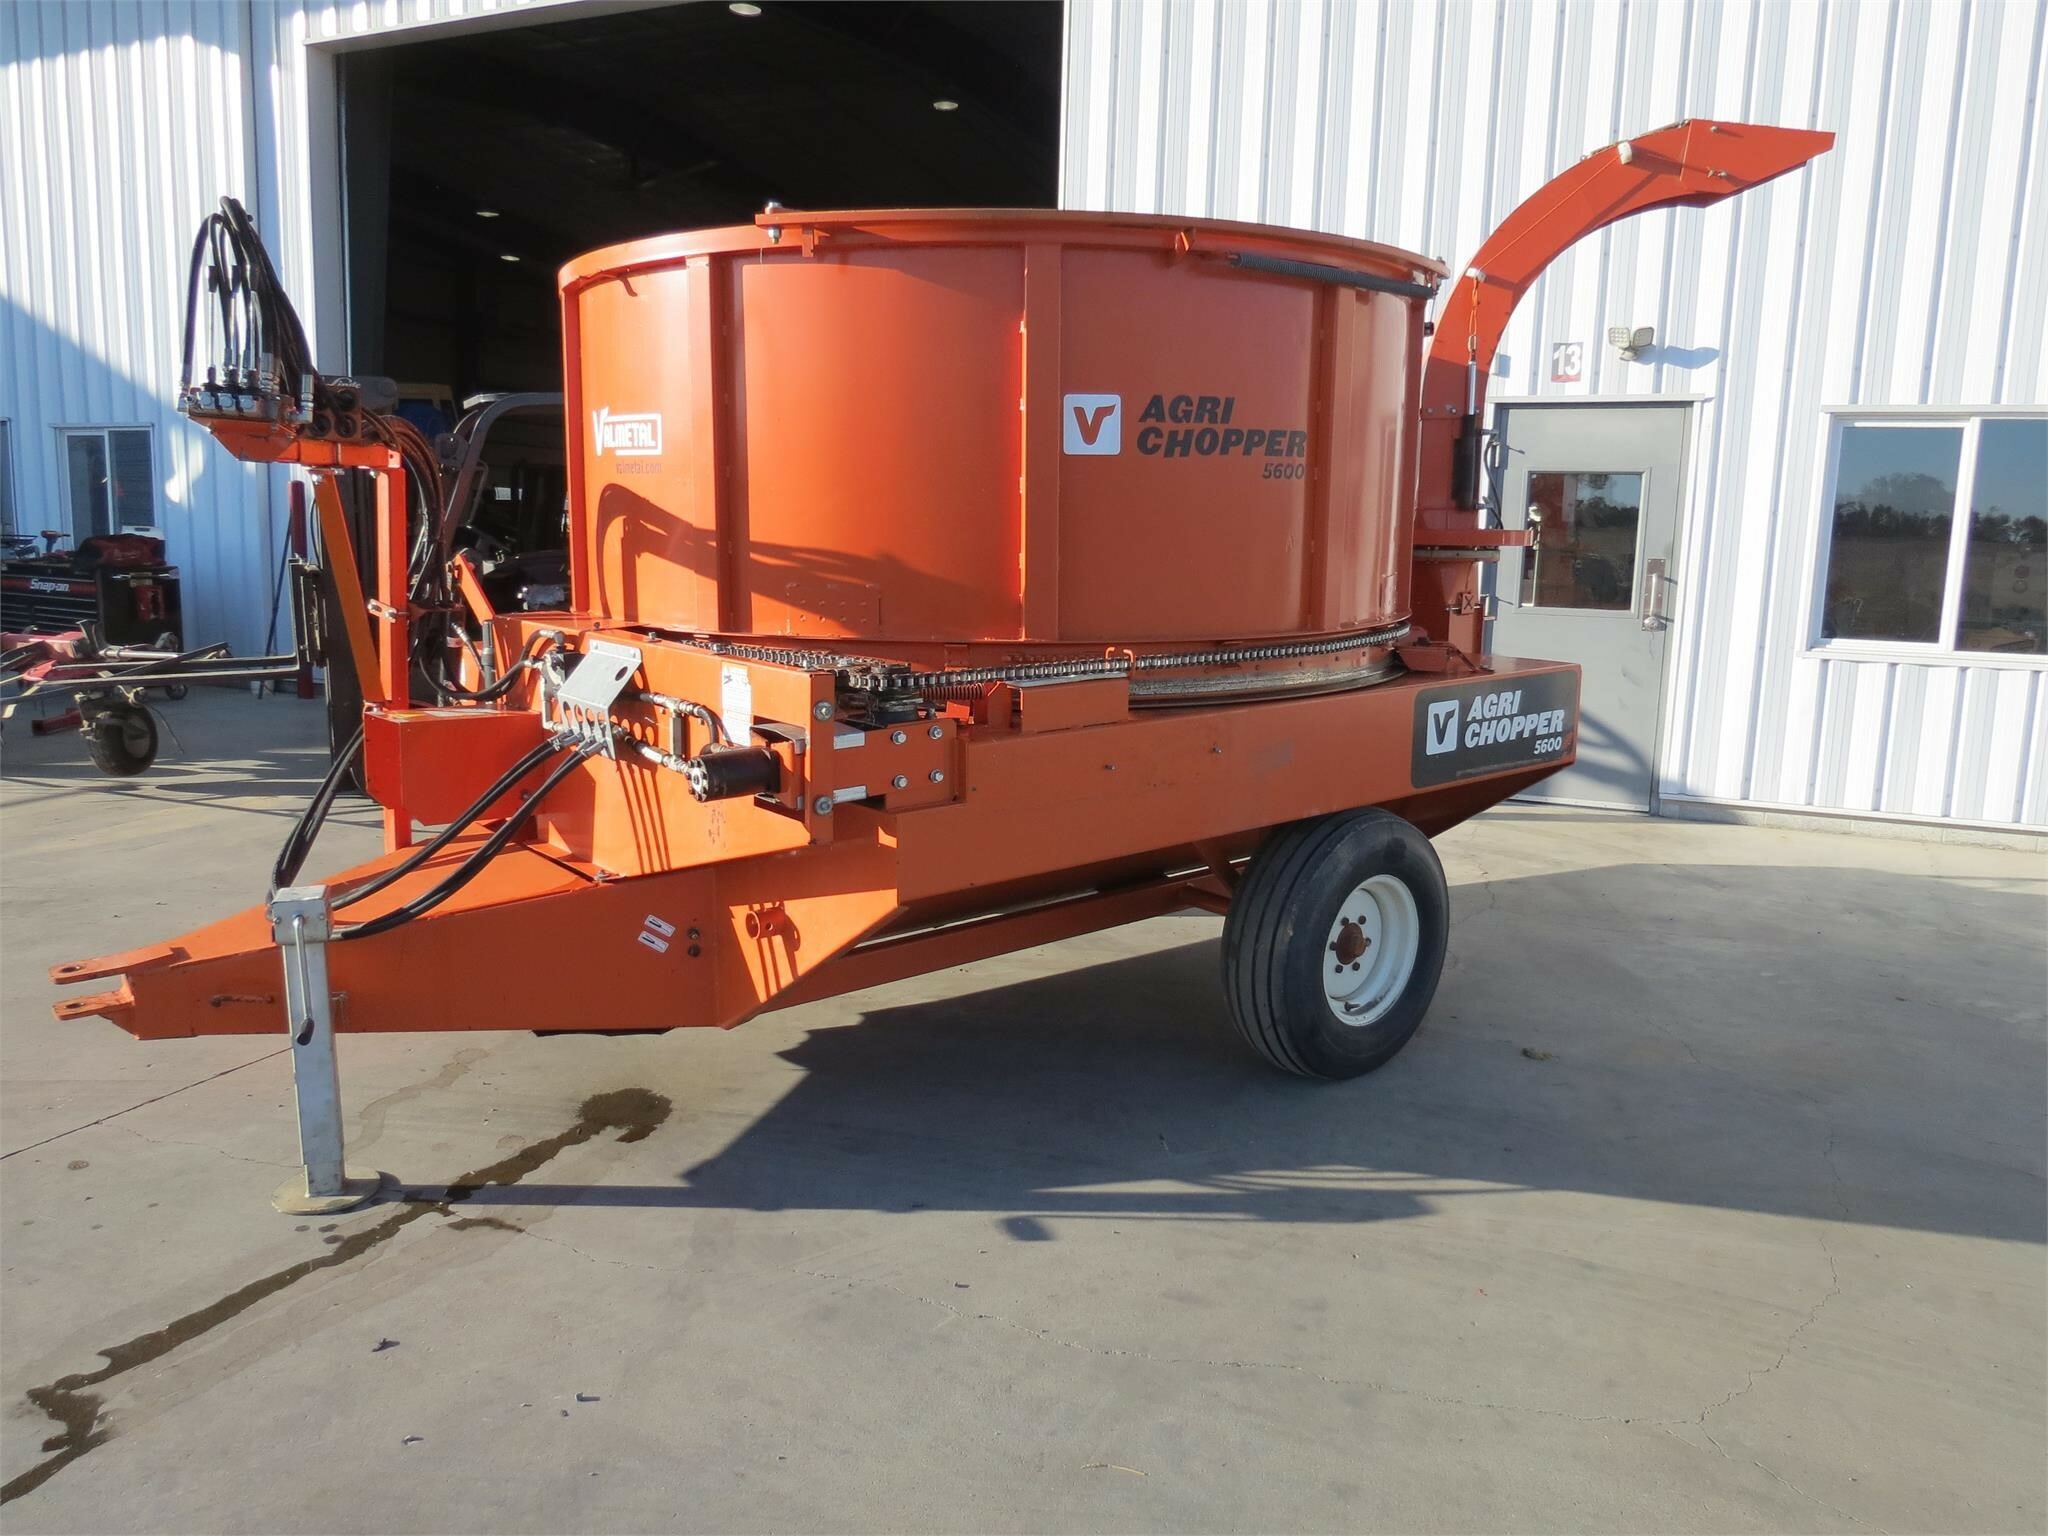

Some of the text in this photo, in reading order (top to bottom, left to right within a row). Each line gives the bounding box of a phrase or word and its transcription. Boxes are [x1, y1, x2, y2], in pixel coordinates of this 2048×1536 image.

[1553, 344, 1581, 376] 13
[1138, 394, 1235, 424] AGRI
[592, 406, 658, 457] VALMETAL
[1137, 427, 1306, 458] CHOPPER
[1262, 463, 1305, 480] 5600
[30, 578, 70, 592] Snap-on
[1466, 690, 1522, 721] AGRI
[1465, 709, 1565, 748] CHOPPER
[1533, 736, 1562, 755] 5600
